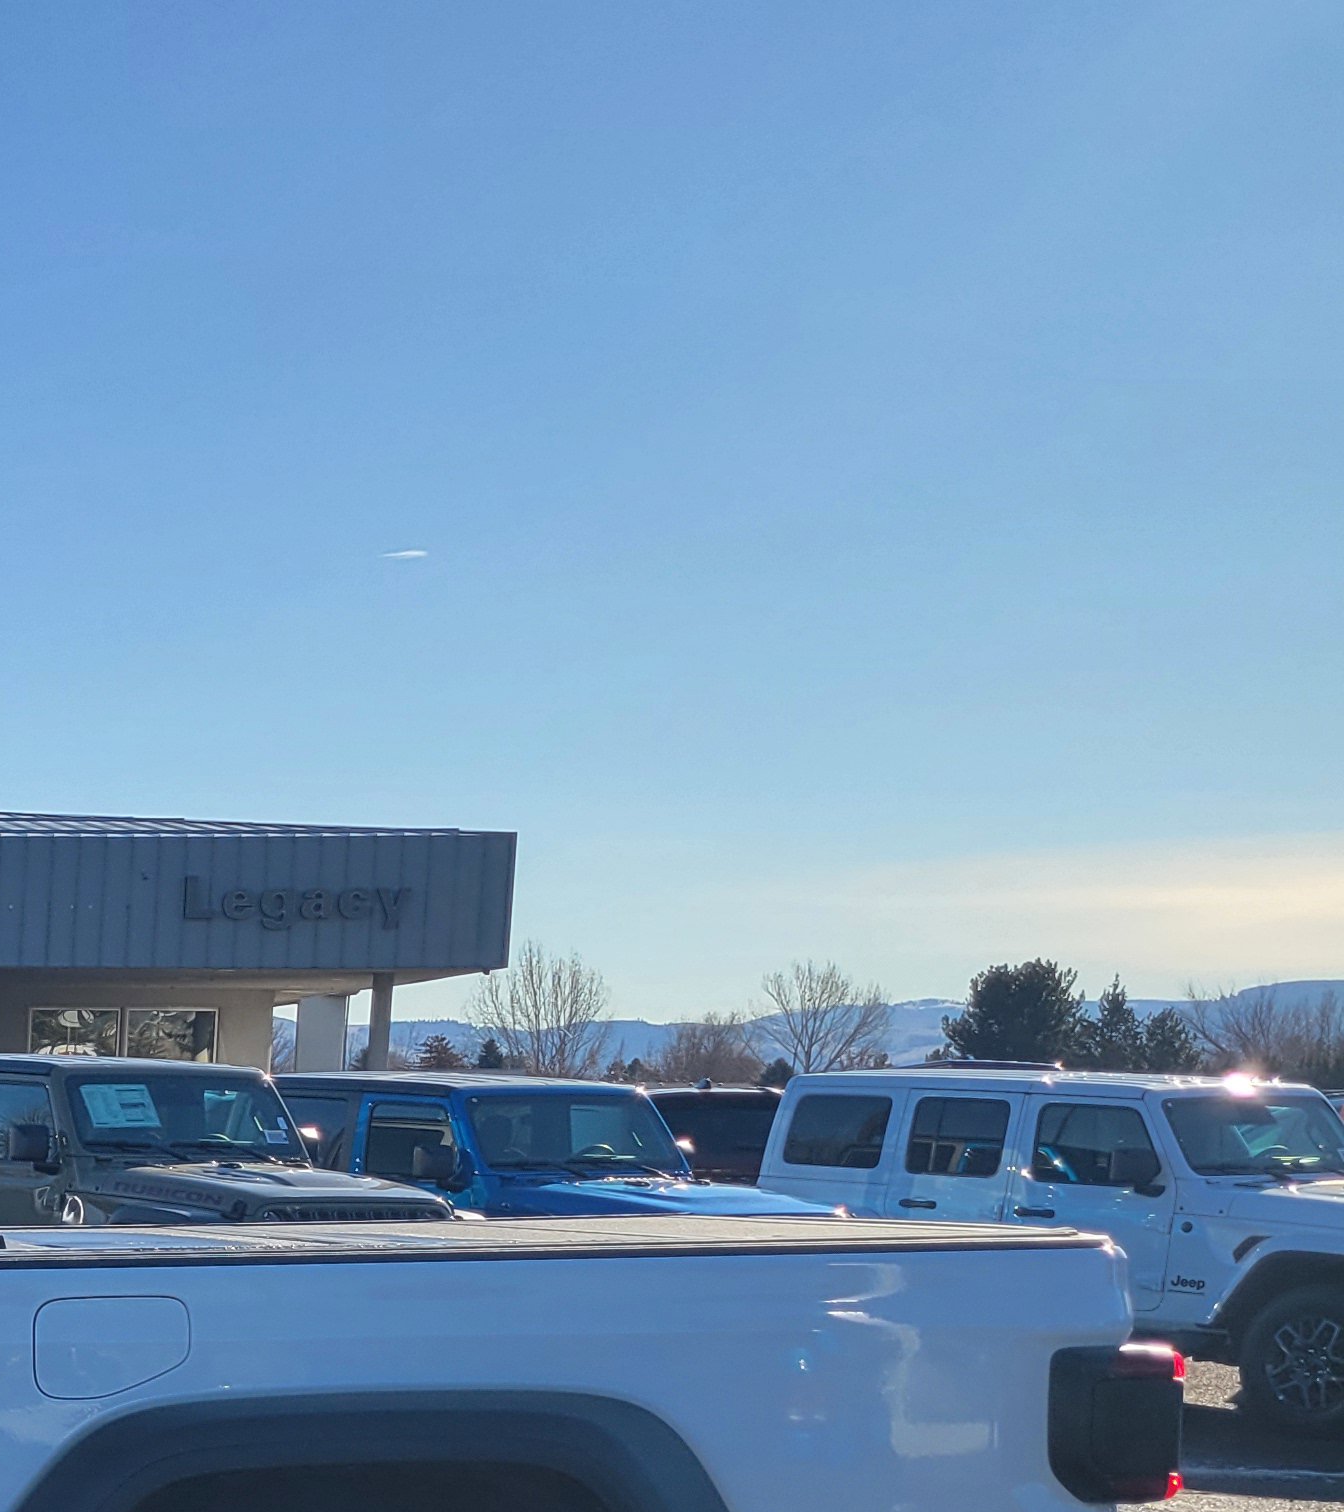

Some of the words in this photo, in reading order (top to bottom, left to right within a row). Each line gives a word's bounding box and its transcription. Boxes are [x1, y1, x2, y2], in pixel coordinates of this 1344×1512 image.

[183, 875, 411, 931] Legacy
[114, 1181, 224, 1206] RUBICON
[1170, 1274, 1206, 1290] Jeep
